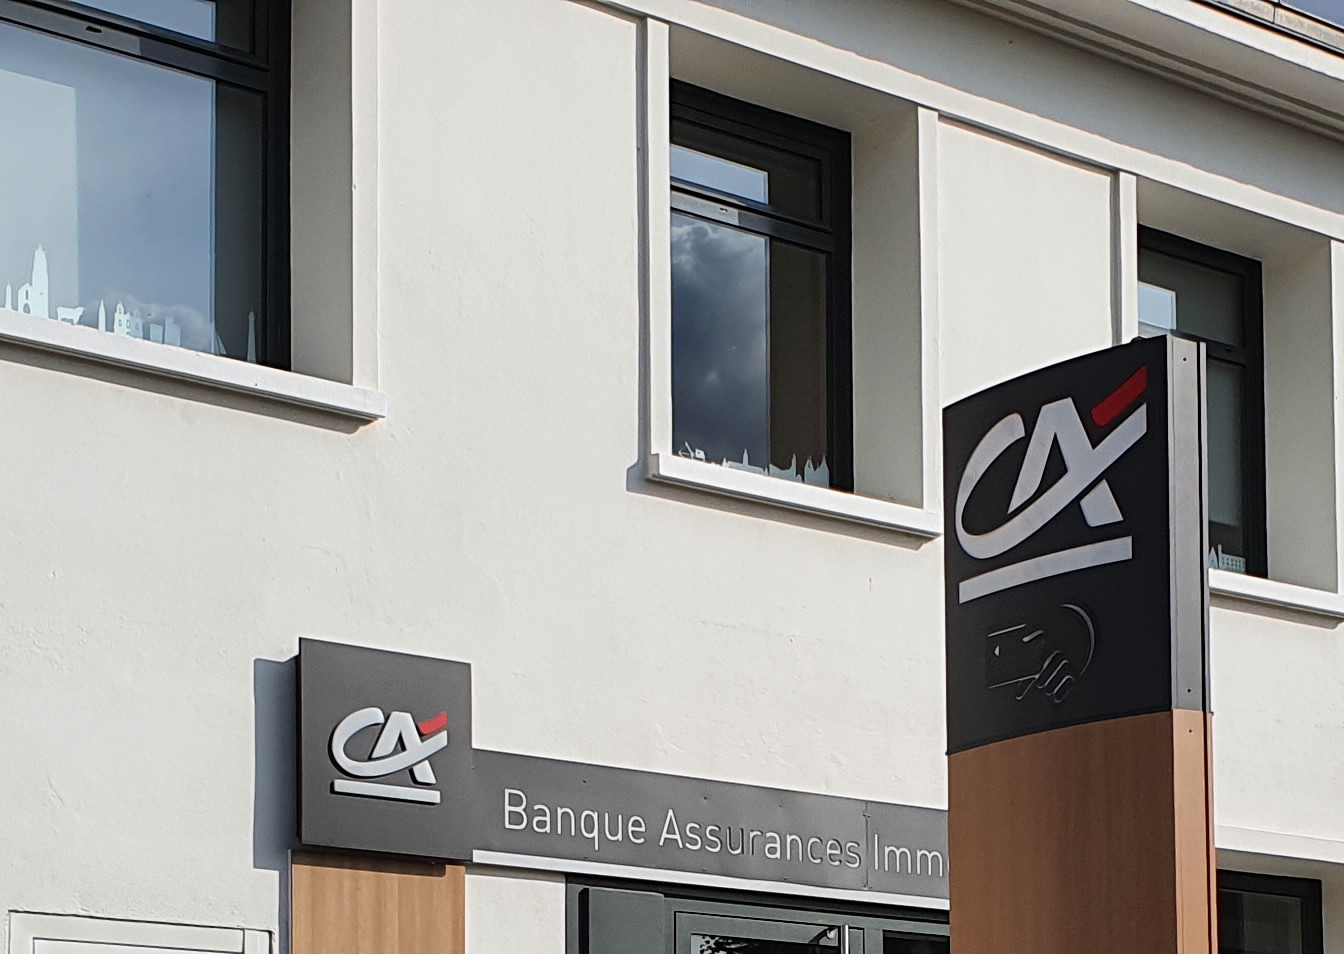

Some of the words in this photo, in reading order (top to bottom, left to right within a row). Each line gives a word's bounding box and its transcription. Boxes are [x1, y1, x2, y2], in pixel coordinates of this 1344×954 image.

[331, 705, 448, 785] CA
[503, 787, 647, 851] Banque
[658, 808, 862, 869] Assurances
[872, 832, 948, 879] Imm
